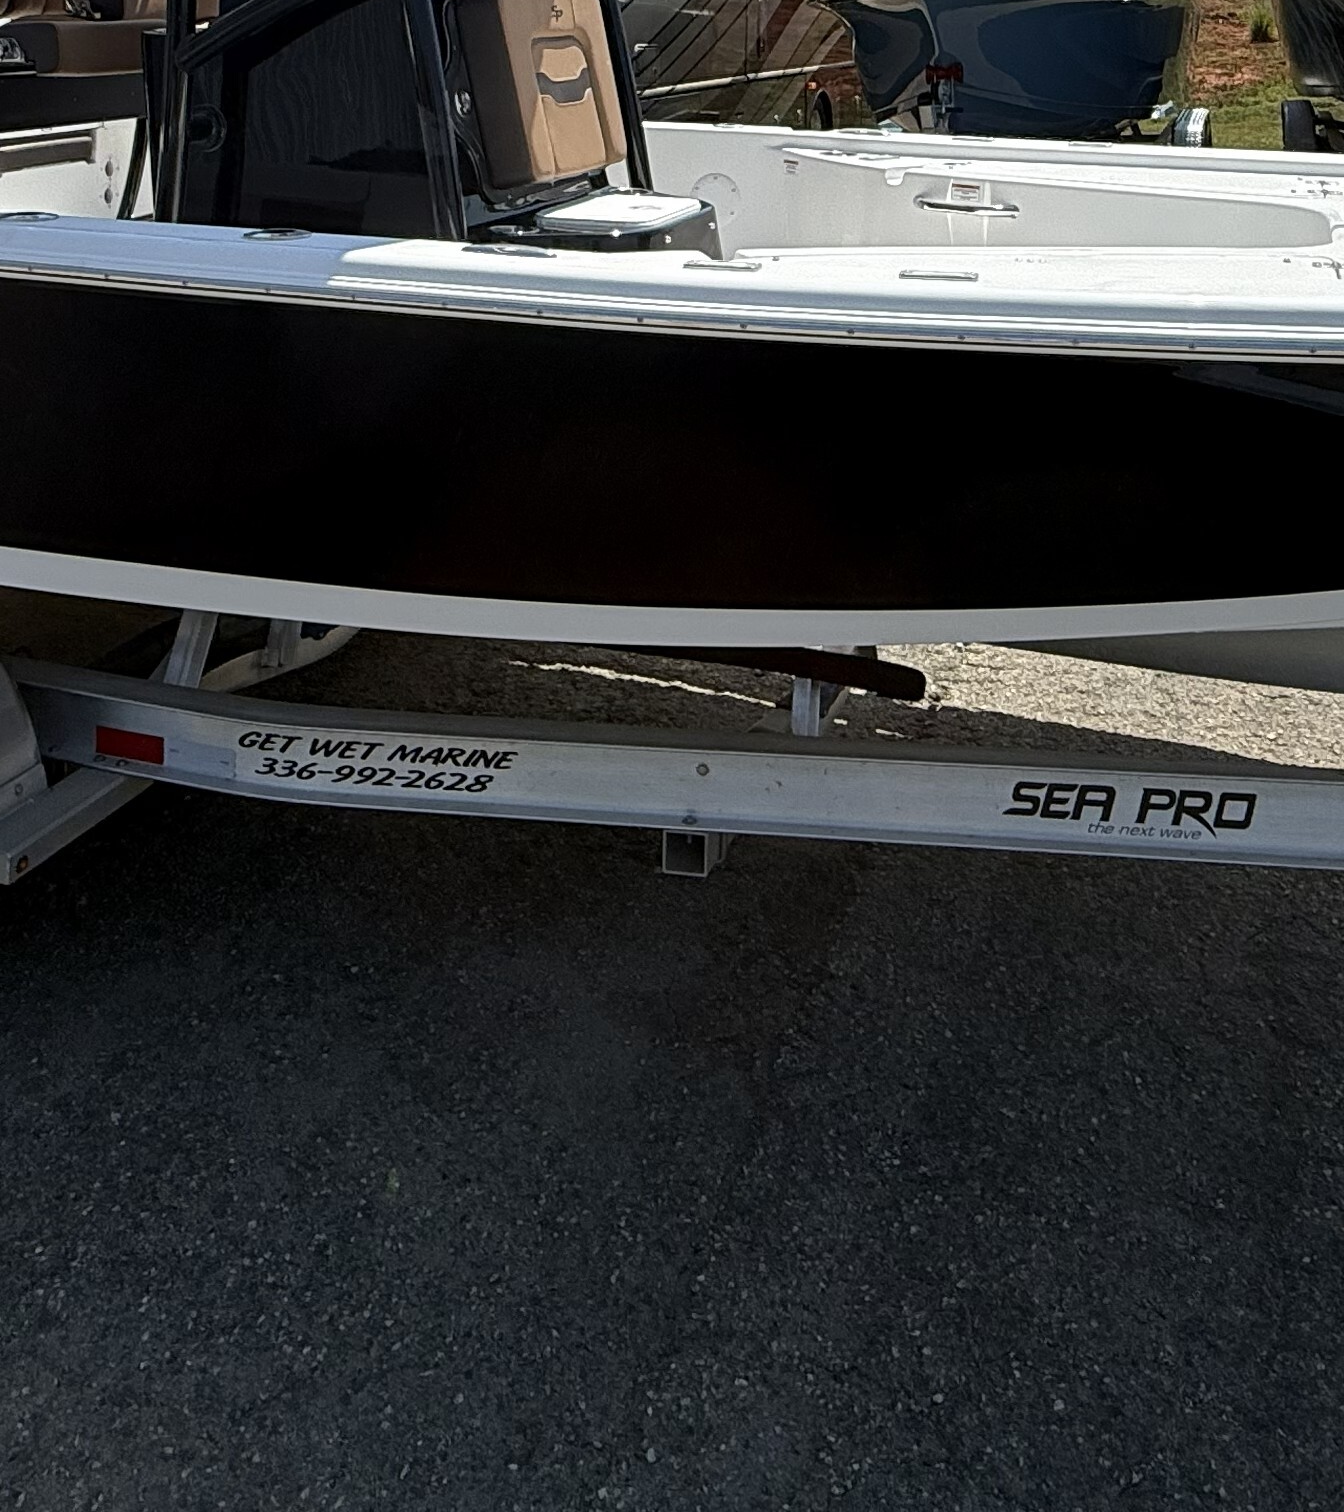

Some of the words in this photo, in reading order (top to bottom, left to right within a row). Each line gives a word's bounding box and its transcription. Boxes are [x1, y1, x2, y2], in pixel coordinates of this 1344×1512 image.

[238, 731, 303, 755] GET
[309, 738, 385, 761] WET
[387, 744, 519, 770] MARINE
[254, 757, 495, 793] 336-992-2628
[1002, 781, 1116, 822] SEA
[1135, 787, 1258, 839] PRO
[1087, 821, 1115, 836] the
[1118, 823, 1155, 838] next
[1160, 829, 1203, 841] wave
